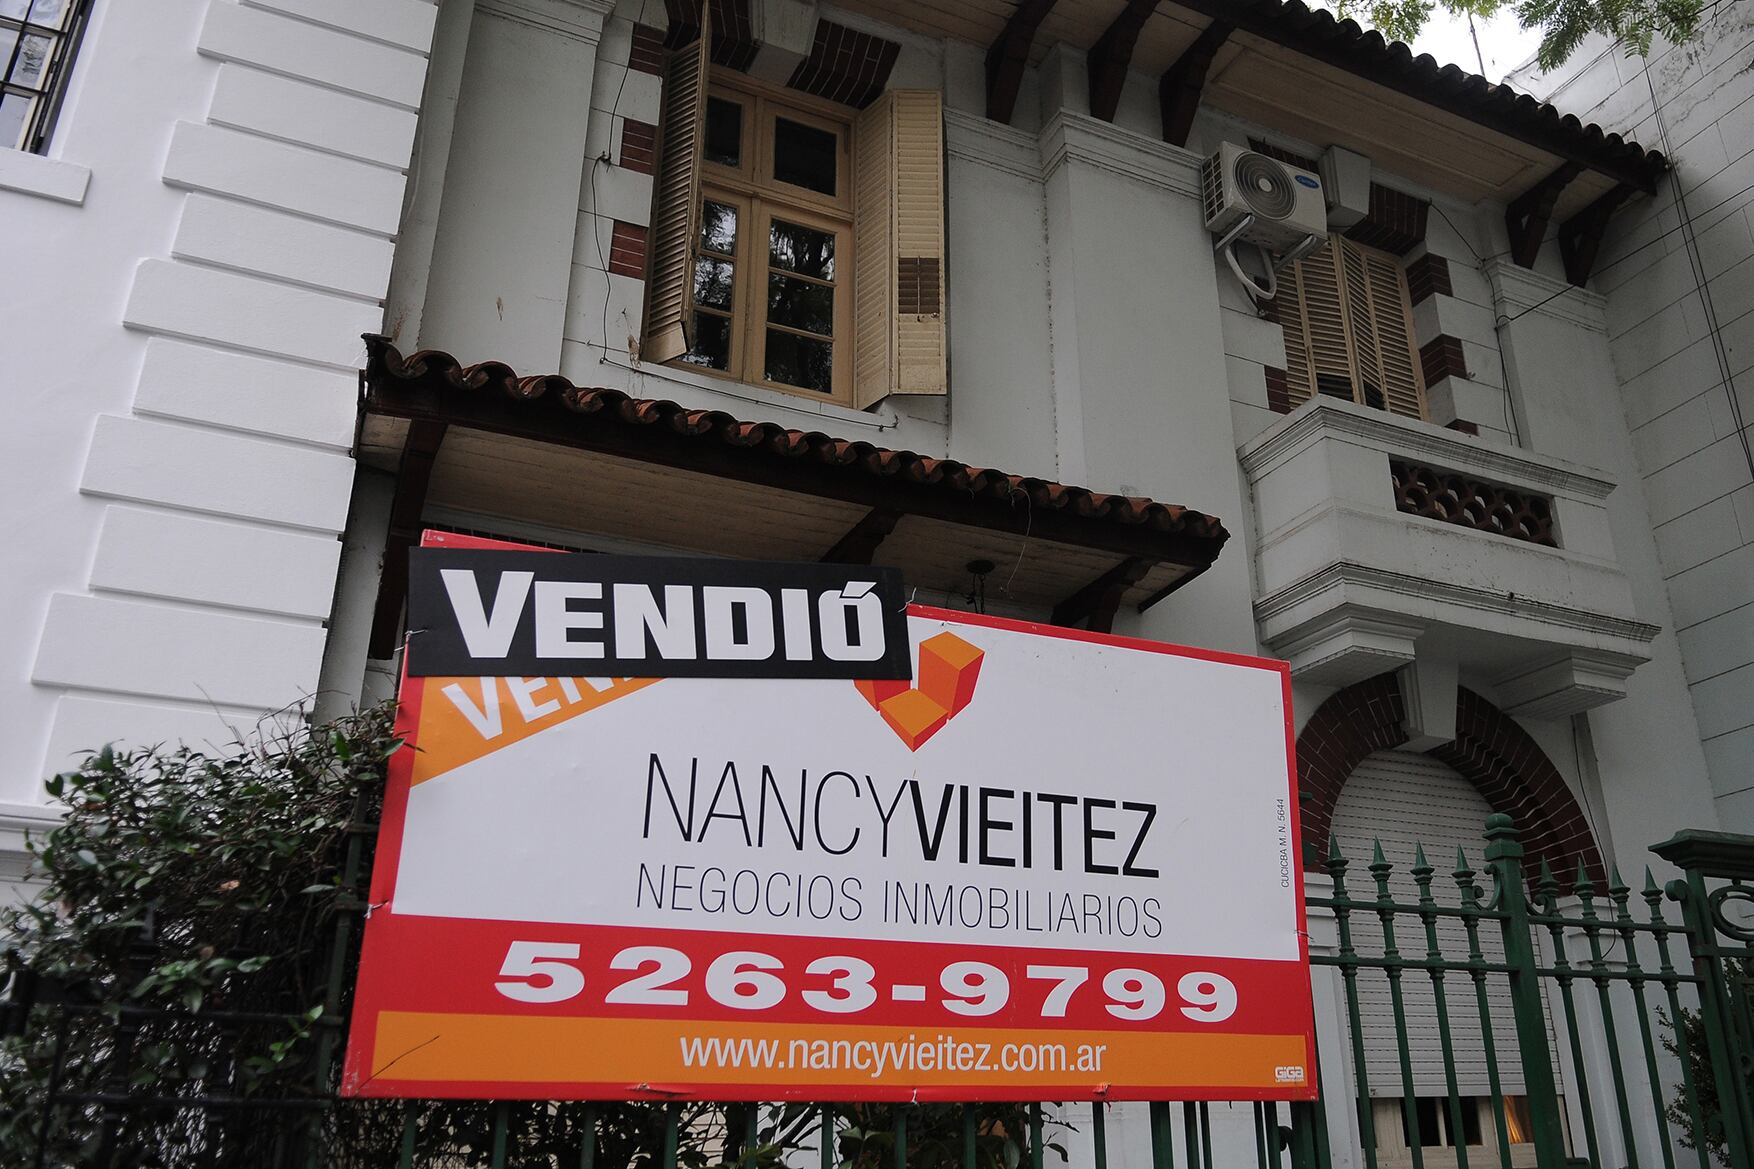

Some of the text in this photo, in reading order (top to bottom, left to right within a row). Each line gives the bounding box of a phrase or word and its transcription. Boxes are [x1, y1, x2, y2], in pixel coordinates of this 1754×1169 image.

[440, 568, 886, 661] VENDIÓ
[1276, 798, 1290, 888] CUCICBA M. N. 5644
[637, 863, 1162, 938] NEGOCIOS INMOBILIARIOS
[494, 940, 1238, 1022] 5263-9799
[679, 1034, 1107, 1078] www.nancyvieitez.com.ar
